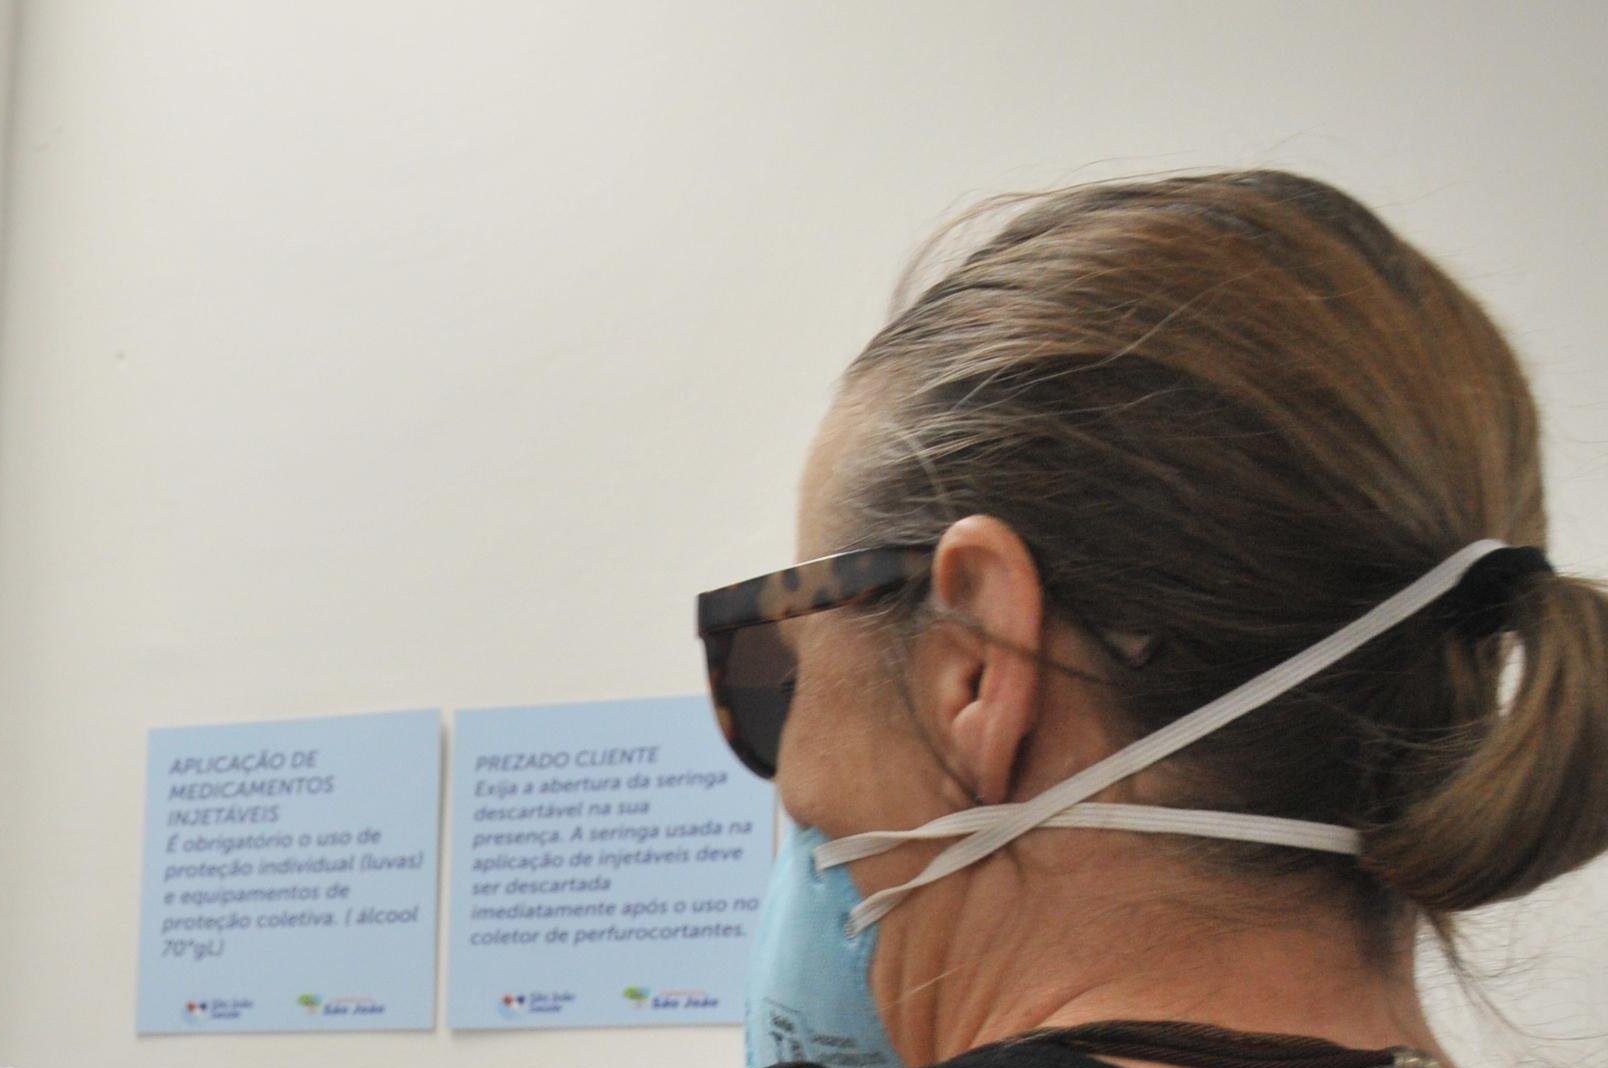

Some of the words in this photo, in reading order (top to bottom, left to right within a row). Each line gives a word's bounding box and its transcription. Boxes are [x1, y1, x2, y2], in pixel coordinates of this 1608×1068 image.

[168, 750, 287, 777] APLICAÇÃO
[290, 749, 318, 769] DE
[475, 751, 569, 773] PREZADO
[575, 746, 660, 767] CLIENTE
[168, 775, 335, 801] MEDICAMENTOS
[474, 779, 519, 799] Exija
[523, 782, 535, 795] a
[540, 775, 621, 794] abertura
[627, 773, 650, 790] da
[657, 770, 727, 790] seringa
[166, 804, 279, 828] INJETÁVEIS
[473, 801, 583, 822] descartável
[588, 801, 611, 816] na
[617, 800, 650, 815] sua
[166, 834, 180, 854] É
[182, 831, 294, 855] obrigatório
[299, 833, 312, 848] o
[317, 833, 351, 847] uso
[357, 828, 381, 845] de
[472, 829, 561, 850] presença.
[568, 824, 584, 841] A
[589, 820, 659, 844] seringa
[665, 820, 722, 838] usada
[728, 820, 752, 834] na
[164, 857, 251, 882] proteção
[258, 855, 355, 876] individual
[360, 851, 424, 876] (luvas)
[472, 852, 564, 873] aplicação
[568, 851, 593, 866] de
[598, 845, 689, 868] injetáveis
[696, 845, 743, 863] deve
[163, 890, 175, 904] e
[180, 884, 319, 907] equipamentos
[326, 882, 350, 900] de
[472, 880, 501, 896] ser
[505, 875, 611, 895] descartada
[161, 911, 250, 934] proteção
[256, 908, 338, 929] coletiva.
[357, 906, 419, 925] álcool
[471, 900, 617, 921] imediatamente
[621, 897, 667, 918] após
[673, 900, 687, 914] o
[692, 897, 727, 914] uso
[733, 897, 759, 911] no
[470, 926, 540, 946] coletor
[544, 926, 569, 944] de
[573, 923, 746, 946] perfurocortantes.
